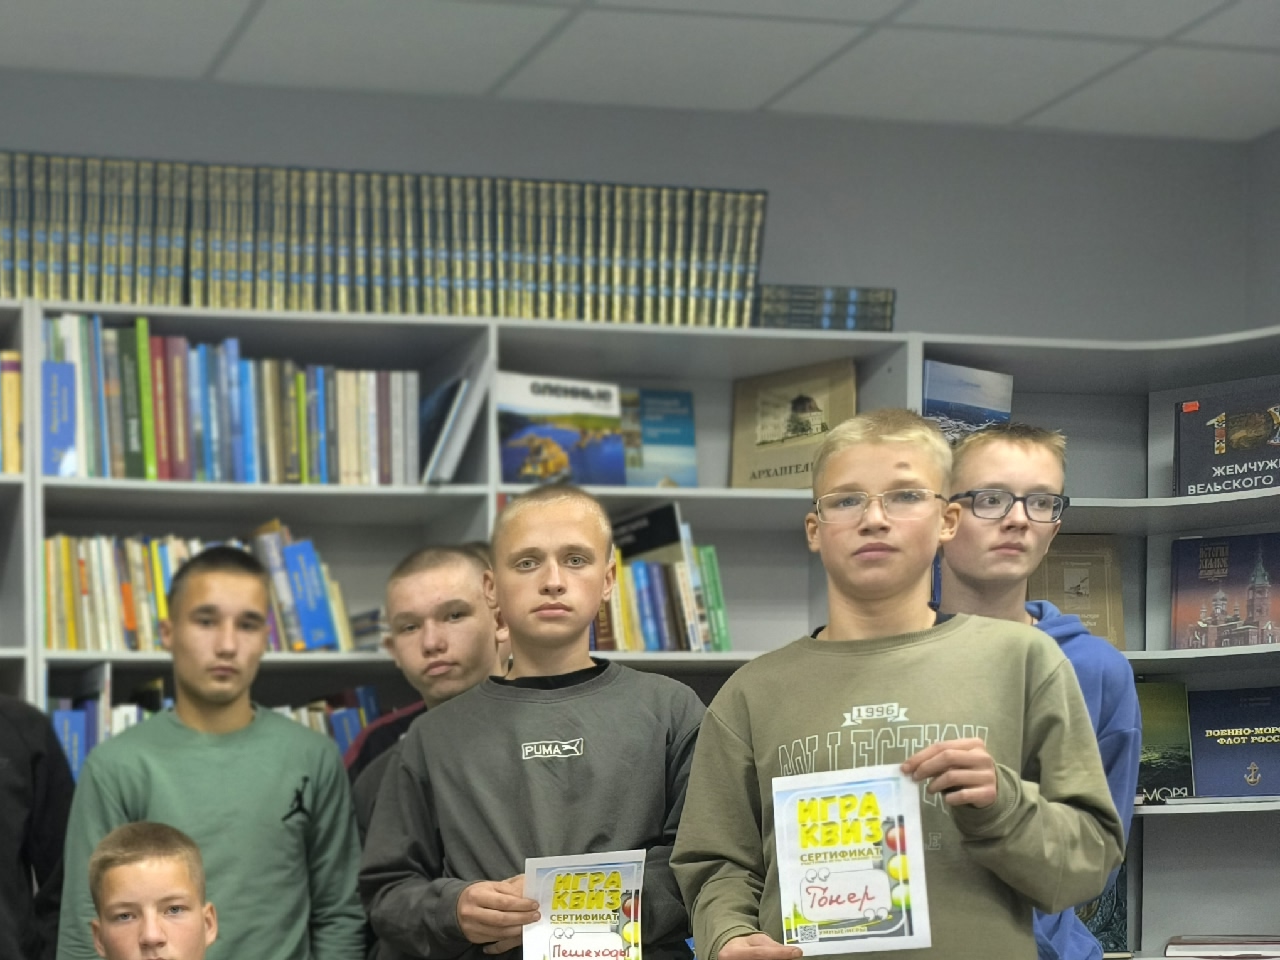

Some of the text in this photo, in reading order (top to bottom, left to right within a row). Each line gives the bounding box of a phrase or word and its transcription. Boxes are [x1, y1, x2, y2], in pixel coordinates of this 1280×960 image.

[1188, 475, 1274, 494] ВЕЛЬСКОГО
[855, 704, 896, 718] 1996
[1217, 734, 1280, 745] ФЛОТ РОСС
[524, 744, 562, 756] PUMA
[797, 791, 882, 825] ИГРА
[799, 816, 884, 849] КВИЗ
[800, 847, 881, 862] СЕРТИФИКАТ
[553, 871, 622, 891] ИГРА
[551, 889, 622, 911] КВИЗ
[550, 913, 618, 922] СЕРТИФИКАТ
